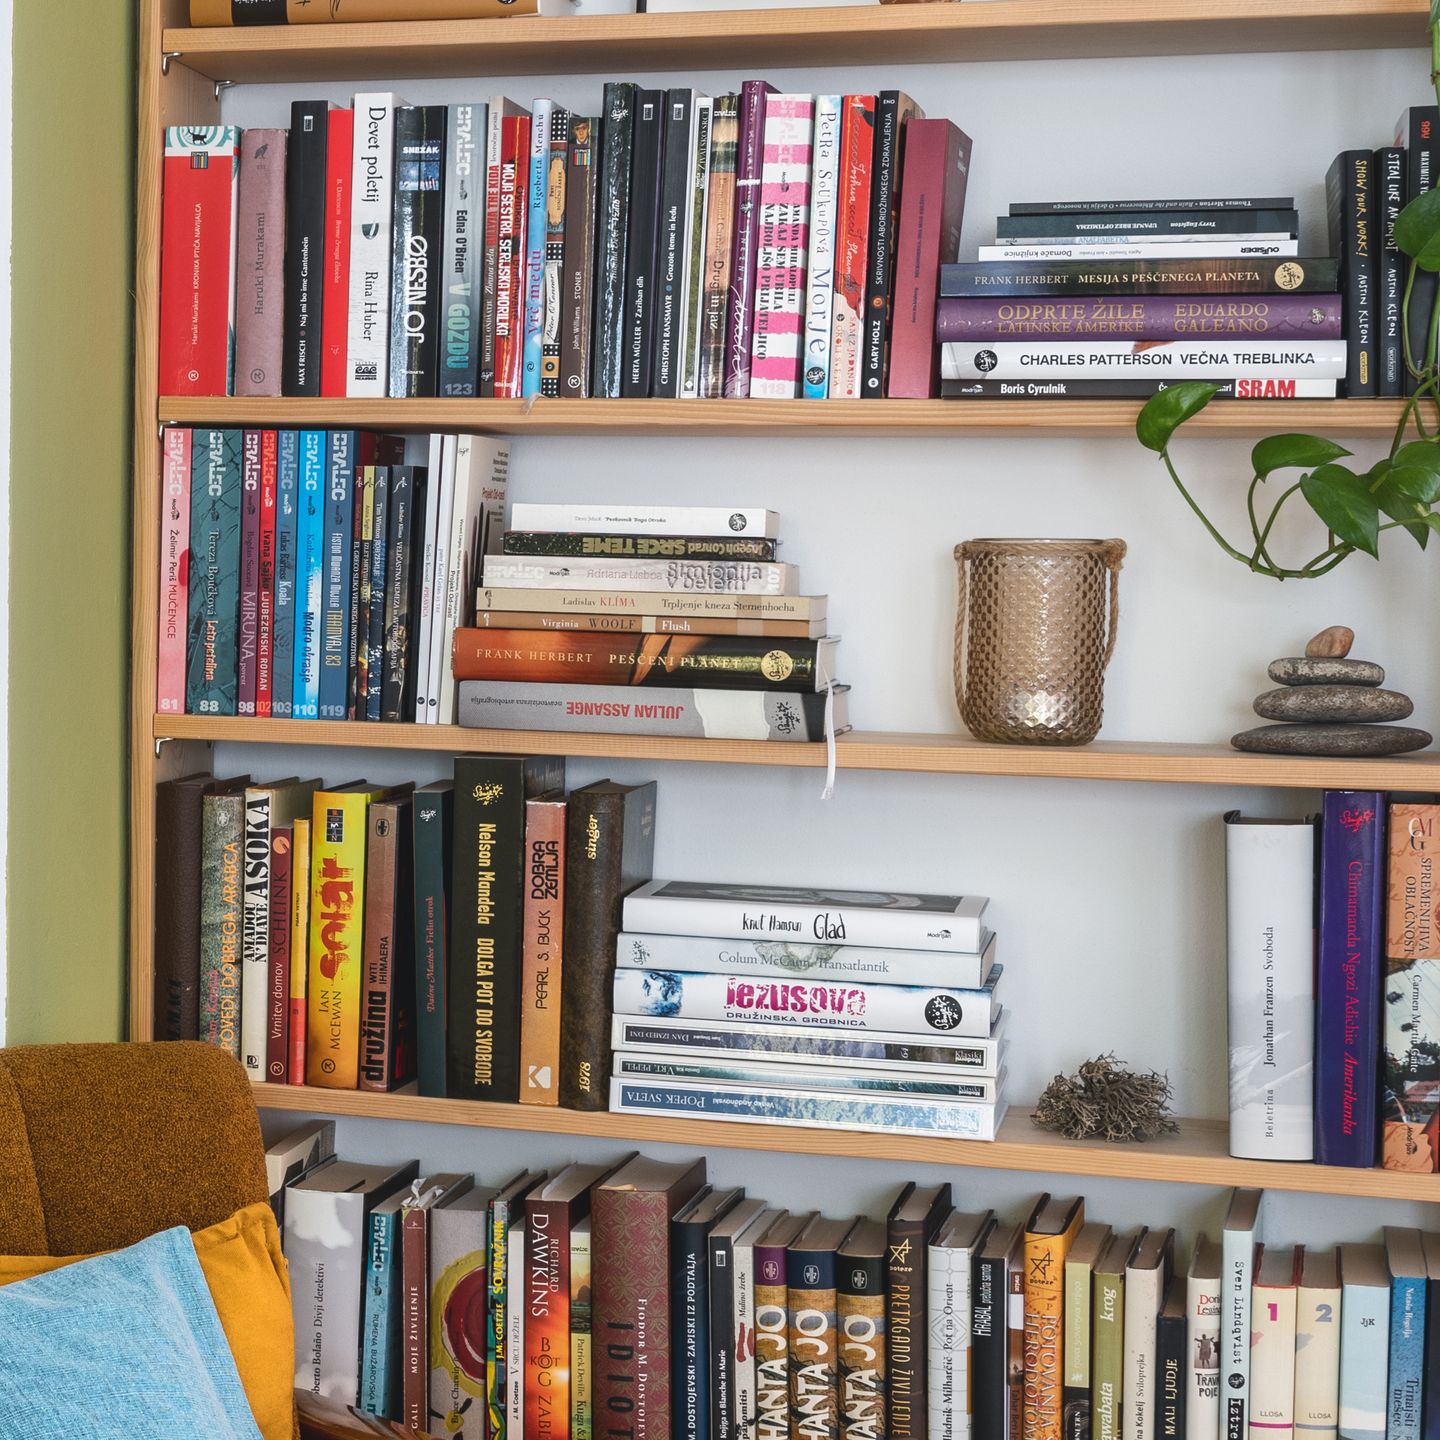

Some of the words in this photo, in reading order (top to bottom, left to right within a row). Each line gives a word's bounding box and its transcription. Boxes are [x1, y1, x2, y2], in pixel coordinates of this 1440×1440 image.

[369, 106, 387, 148] Devet
[361, 153, 382, 203] poletij
[407, 235, 428, 307] NESBØ
[405, 310, 425, 343] JO
[1019, 353, 1085, 366] CHARLES
[1089, 353, 1171, 366] PATTERSON
[1180, 349, 1229, 365] VEČNA
[1232, 351, 1315, 365] TREBLINKA
[445, 384, 472, 395] 123
[1000, 382, 1028, 395] Boris
[1030, 382, 1067, 395] Cyrulnik
[1237, 379, 1296, 398] SRAM
[168, 584, 177, 639] MUČENICE
[542, 618, 579, 629] Virginia
[589, 618, 636, 630] WOOLF
[661, 620, 690, 631] Flush
[161, 699, 179, 710] 81
[200, 700, 219, 711] 88
[566, 701, 631, 717] ASSANGE
[634, 705, 684, 719] JULIAN
[479, 823, 496, 867] Nelson
[586, 814, 599, 860] singer
[531, 840, 545, 900] DOBRA
[544, 840, 559, 900] ZEMLJA
[476, 871, 496, 925] Mandela
[1404, 875, 1416, 953] OBLAČNOST
[1420, 857, 1433, 953] SPREMENLJIVA
[813, 914, 847, 940] Glad
[1264, 927, 1274, 971] Svoboda
[1264, 976, 1274, 1016] Franzen
[1264, 1020, 1276, 1067] Jonathan
[579, 1062, 590, 1093] 1978
[530, 1212, 550, 1318] DAWKINS
[549, 1239, 560, 1293] RICHARD
[1100, 1287, 1117, 1322] krog
[1268, 1303, 1278, 1321] 1
[1315, 1304, 1332, 1322] 2
[756, 1306, 787, 1353] JO
